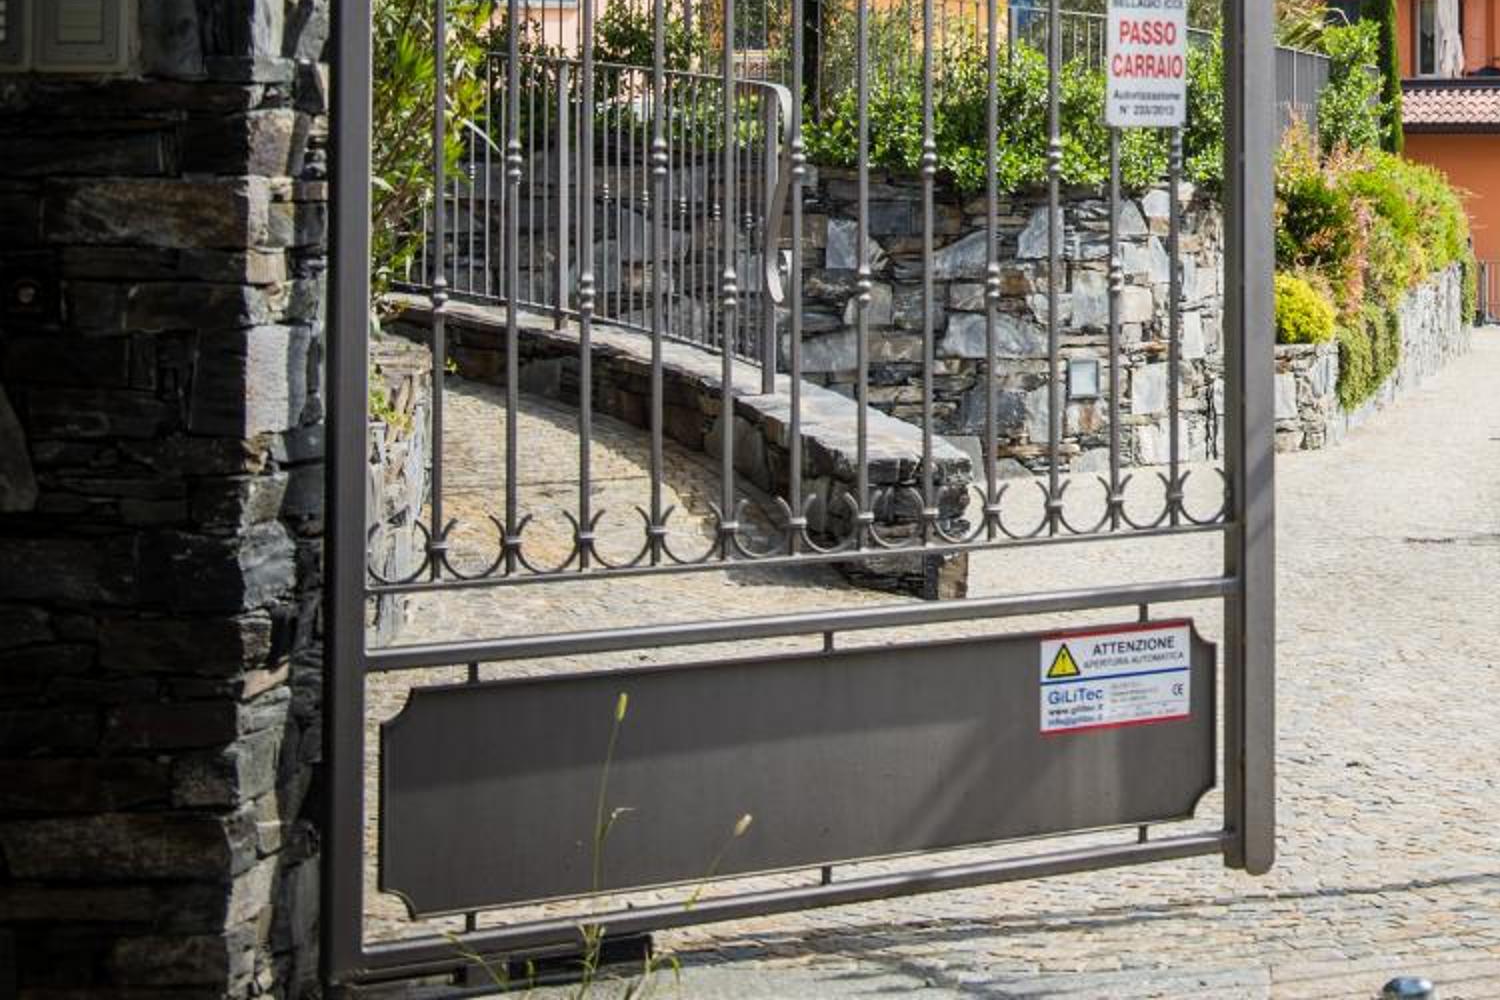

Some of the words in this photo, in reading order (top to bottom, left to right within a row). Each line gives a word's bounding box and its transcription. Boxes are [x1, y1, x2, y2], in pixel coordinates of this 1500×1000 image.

[1119, 20, 1176, 45] PASSO
[1112, 54, 1183, 79] CARRAIO
[1092, 635, 1175, 656] ATTENZIONE
[1132, 651, 1184, 665] AUTOMATICA
